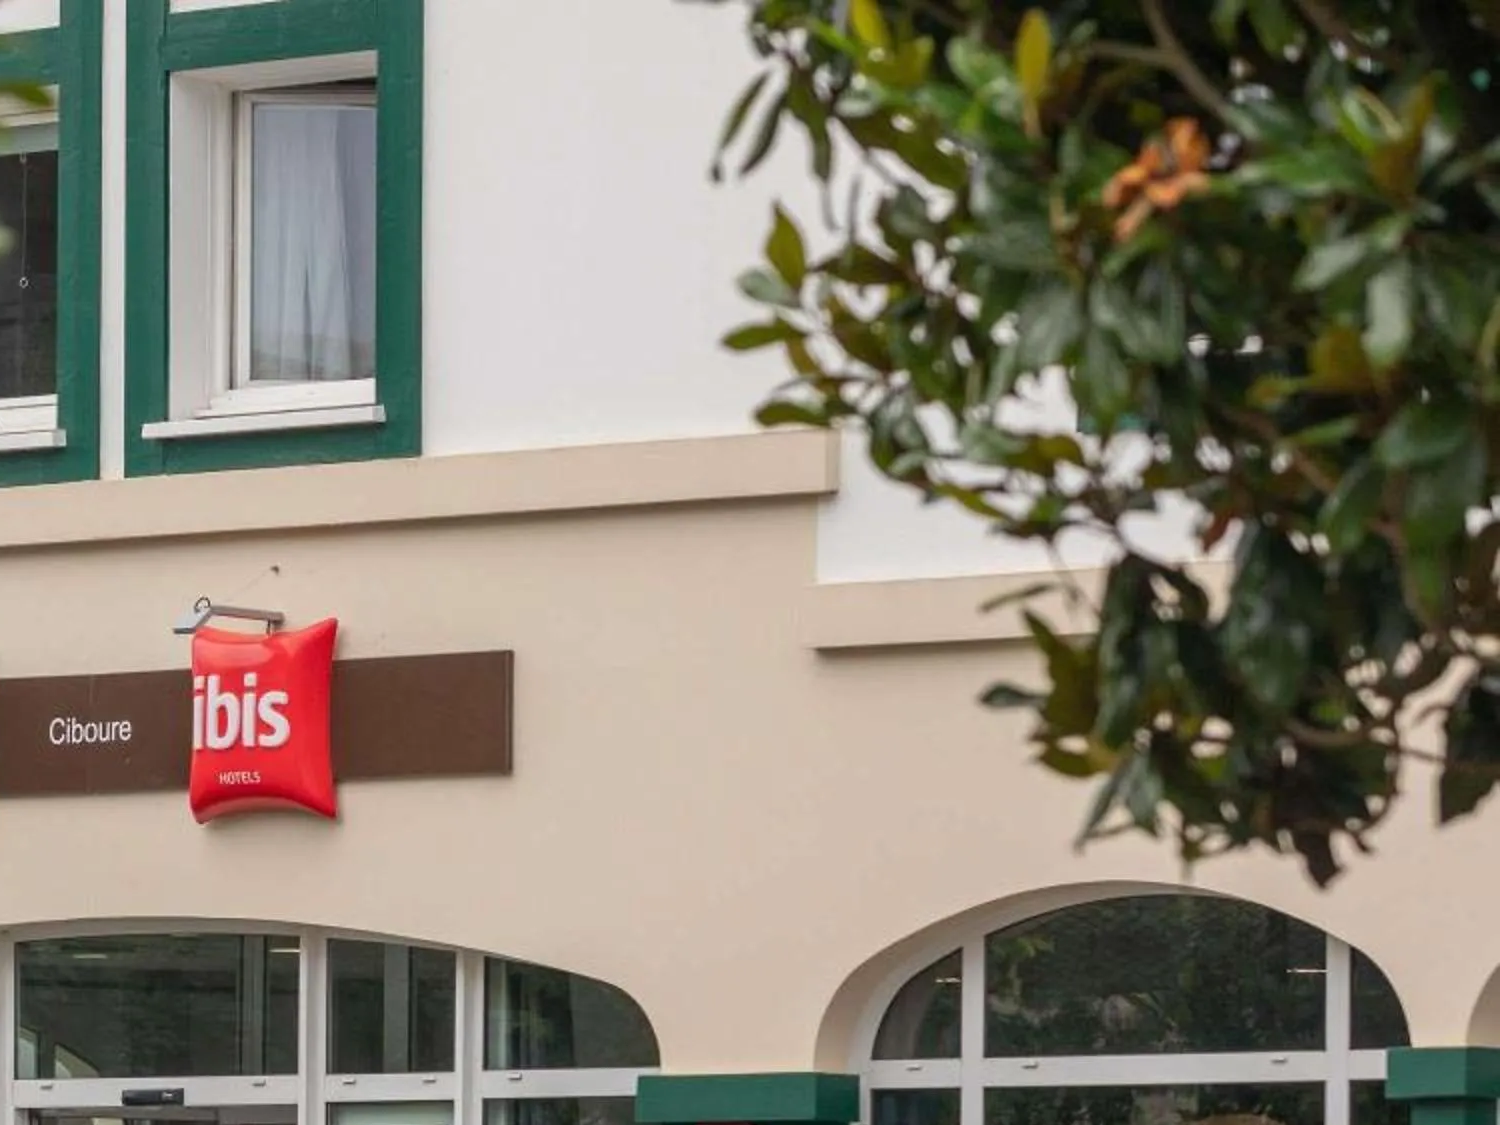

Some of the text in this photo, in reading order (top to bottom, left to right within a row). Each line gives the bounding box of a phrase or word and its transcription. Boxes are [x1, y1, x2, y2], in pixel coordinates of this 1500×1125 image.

[193, 671, 291, 750] ibis
[49, 716, 133, 745] Ciboure
[219, 771, 261, 785] HOTELS
